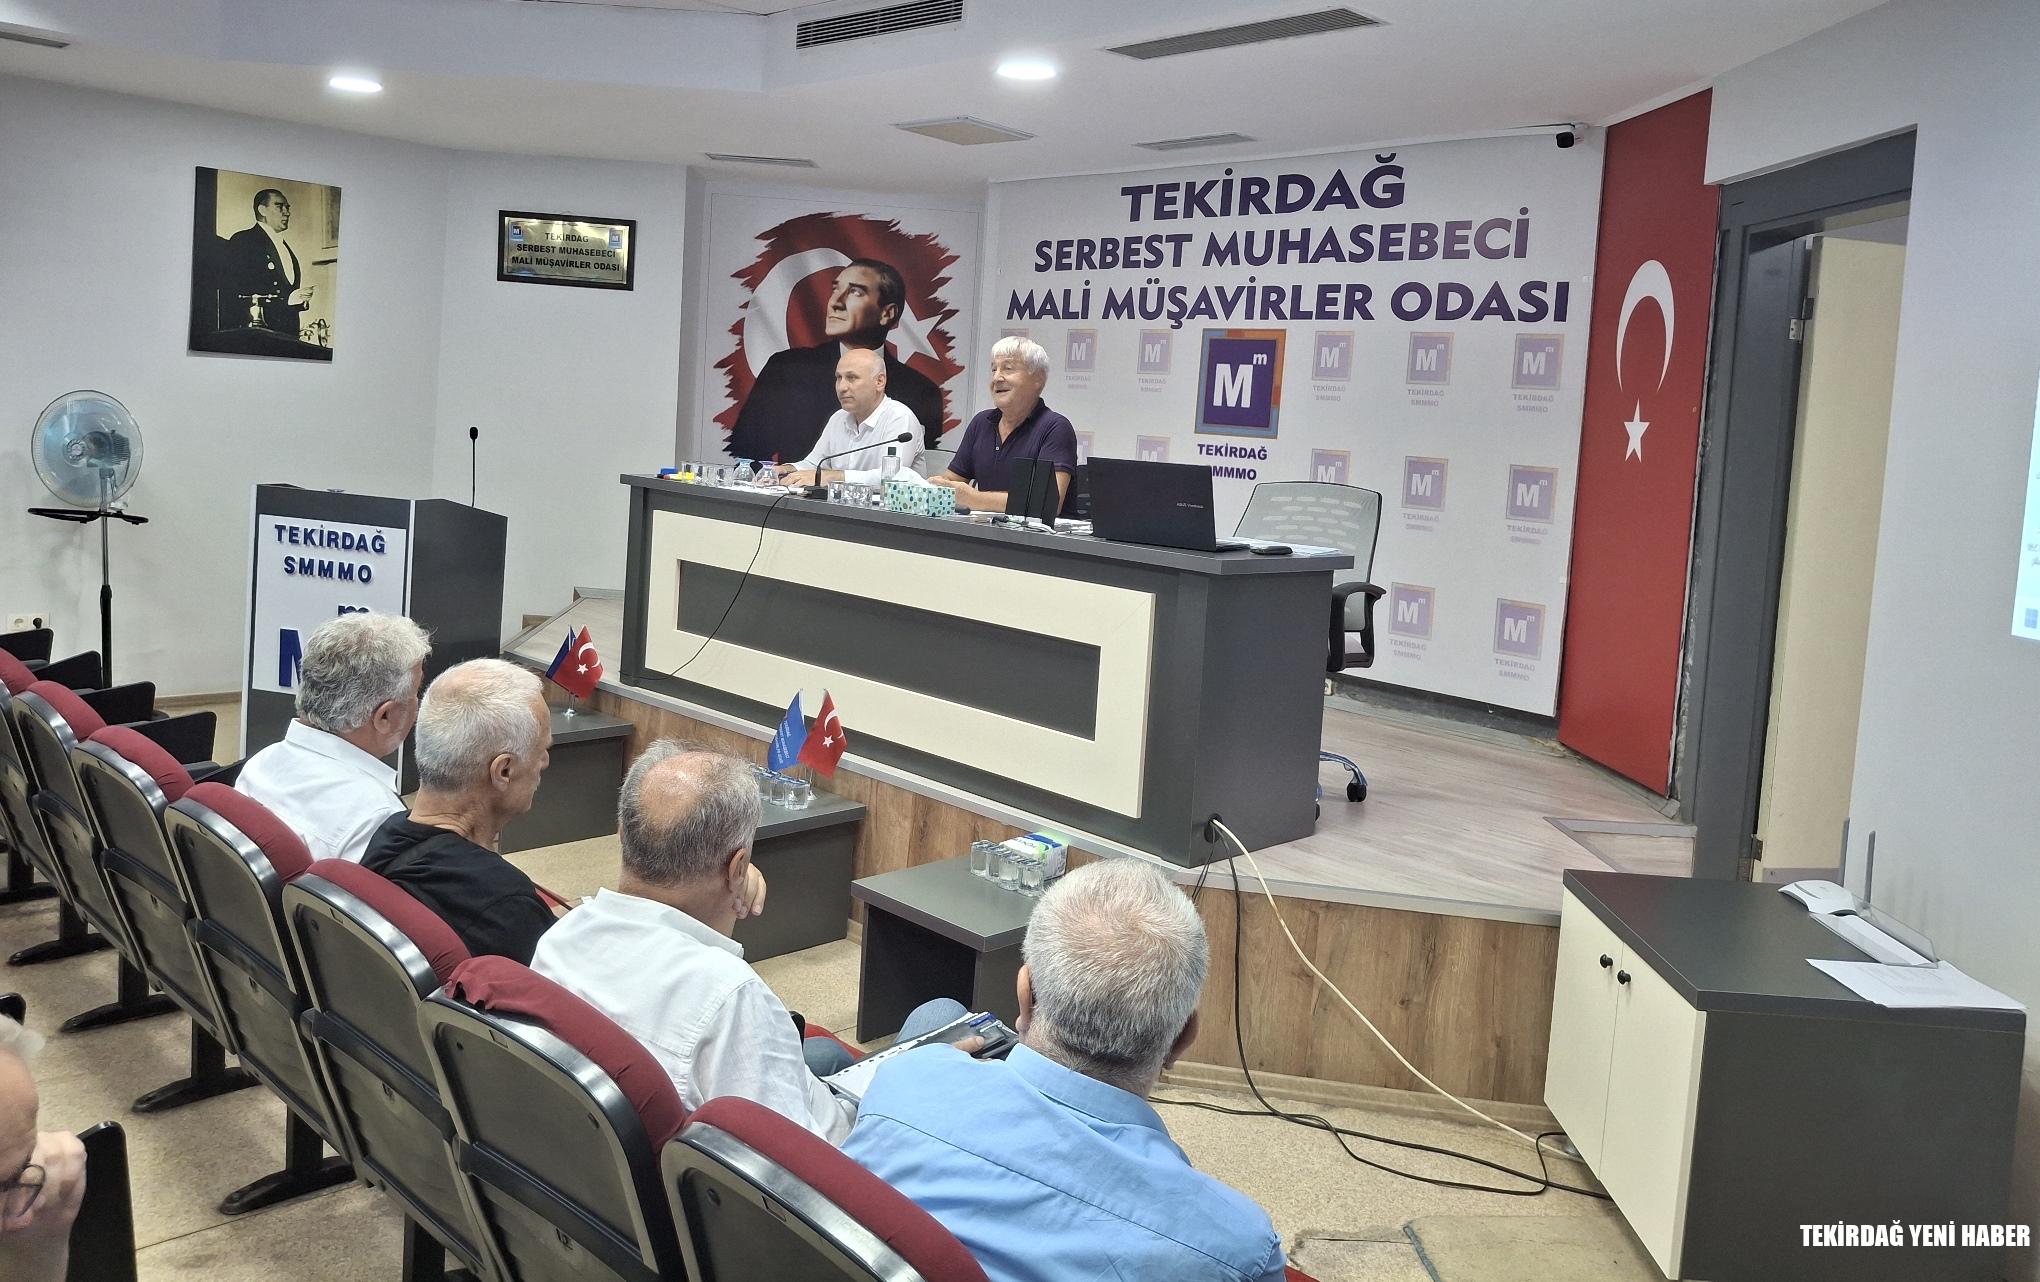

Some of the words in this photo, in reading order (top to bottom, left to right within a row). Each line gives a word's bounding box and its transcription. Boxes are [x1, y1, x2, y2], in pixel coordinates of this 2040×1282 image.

[1121, 153, 1405, 222] TEKİRDAĞ
[516, 243, 556, 254] SERBEST
[1034, 233, 1193, 273] SERBEST
[1202, 206, 1530, 268] MUHASEBECİ
[511, 256, 533, 265] MALİ
[535, 256, 591, 269] MÜŞAVİRLER
[593, 262, 620, 272] ODASI
[1006, 279, 1091, 321] MALİ
[1101, 275, 1375, 329] MÜŞAVİRLER
[1390, 281, 1570, 322] ODASI
[1197, 443, 1268, 461] TEKİRDAĞ
[1212, 465, 1257, 480] MMMO
[275, 525, 386, 554] TEKİRDAĞ
[283, 556, 372, 583] SMMMO
